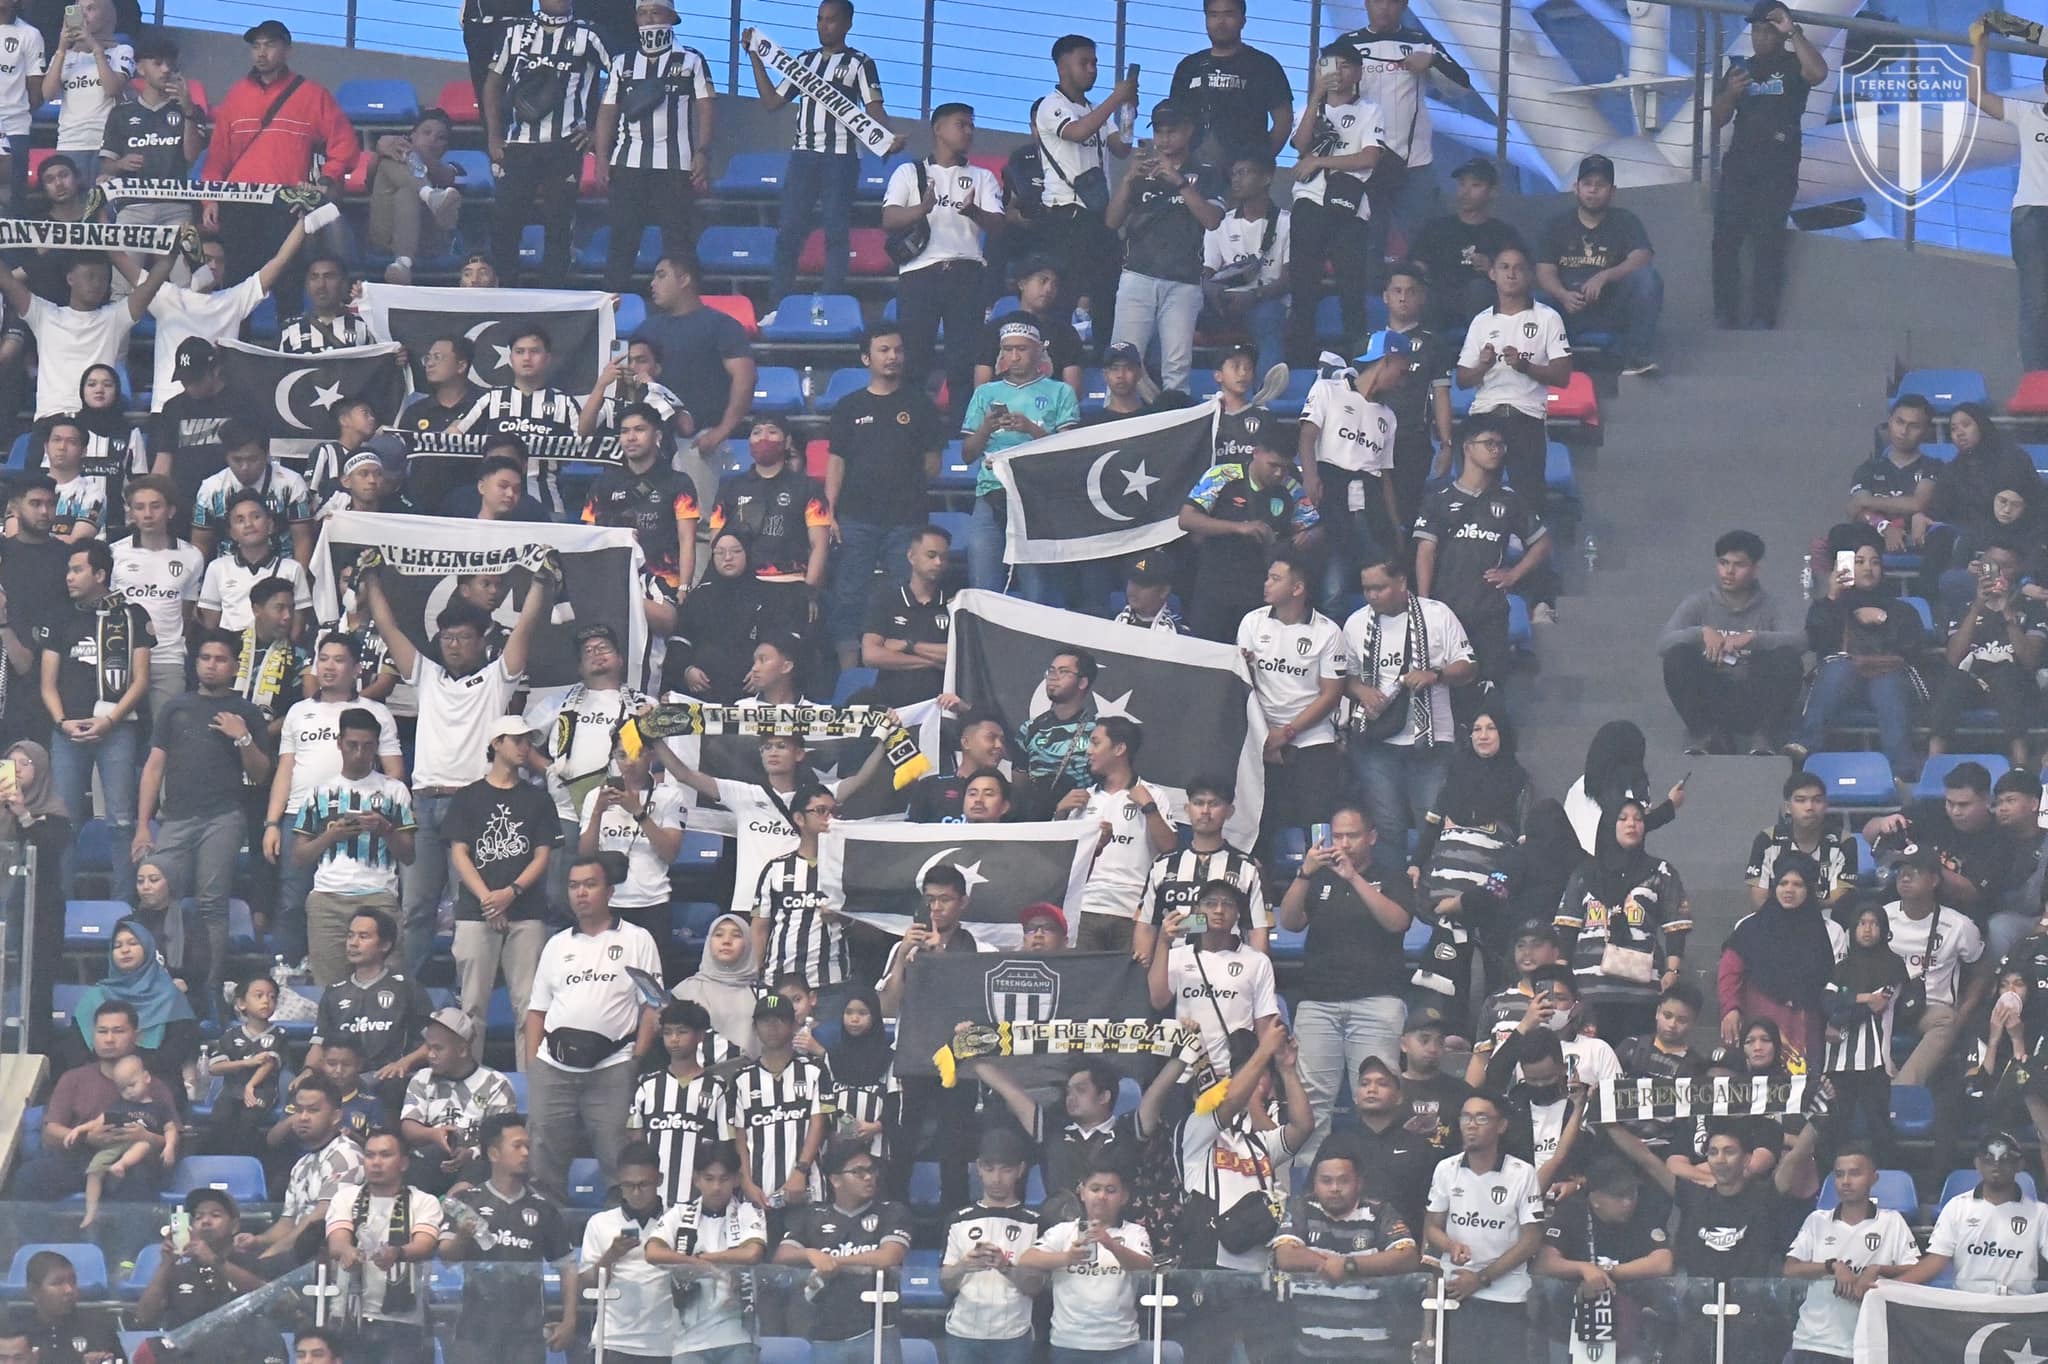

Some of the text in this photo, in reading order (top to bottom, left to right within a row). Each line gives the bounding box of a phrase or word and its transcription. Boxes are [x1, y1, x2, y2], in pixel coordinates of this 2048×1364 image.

[771, 51, 872, 134] TERENGGANU FC
[0, 221, 173, 251] TERENGGANU
[126, 584, 180, 599] Colever
[1257, 657, 1308, 677] Colever
[749, 820, 800, 838] Coleve
[783, 892, 826, 909] Colev
[1451, 1211, 1505, 1230] Colever
[1967, 1241, 2023, 1260] Colever
